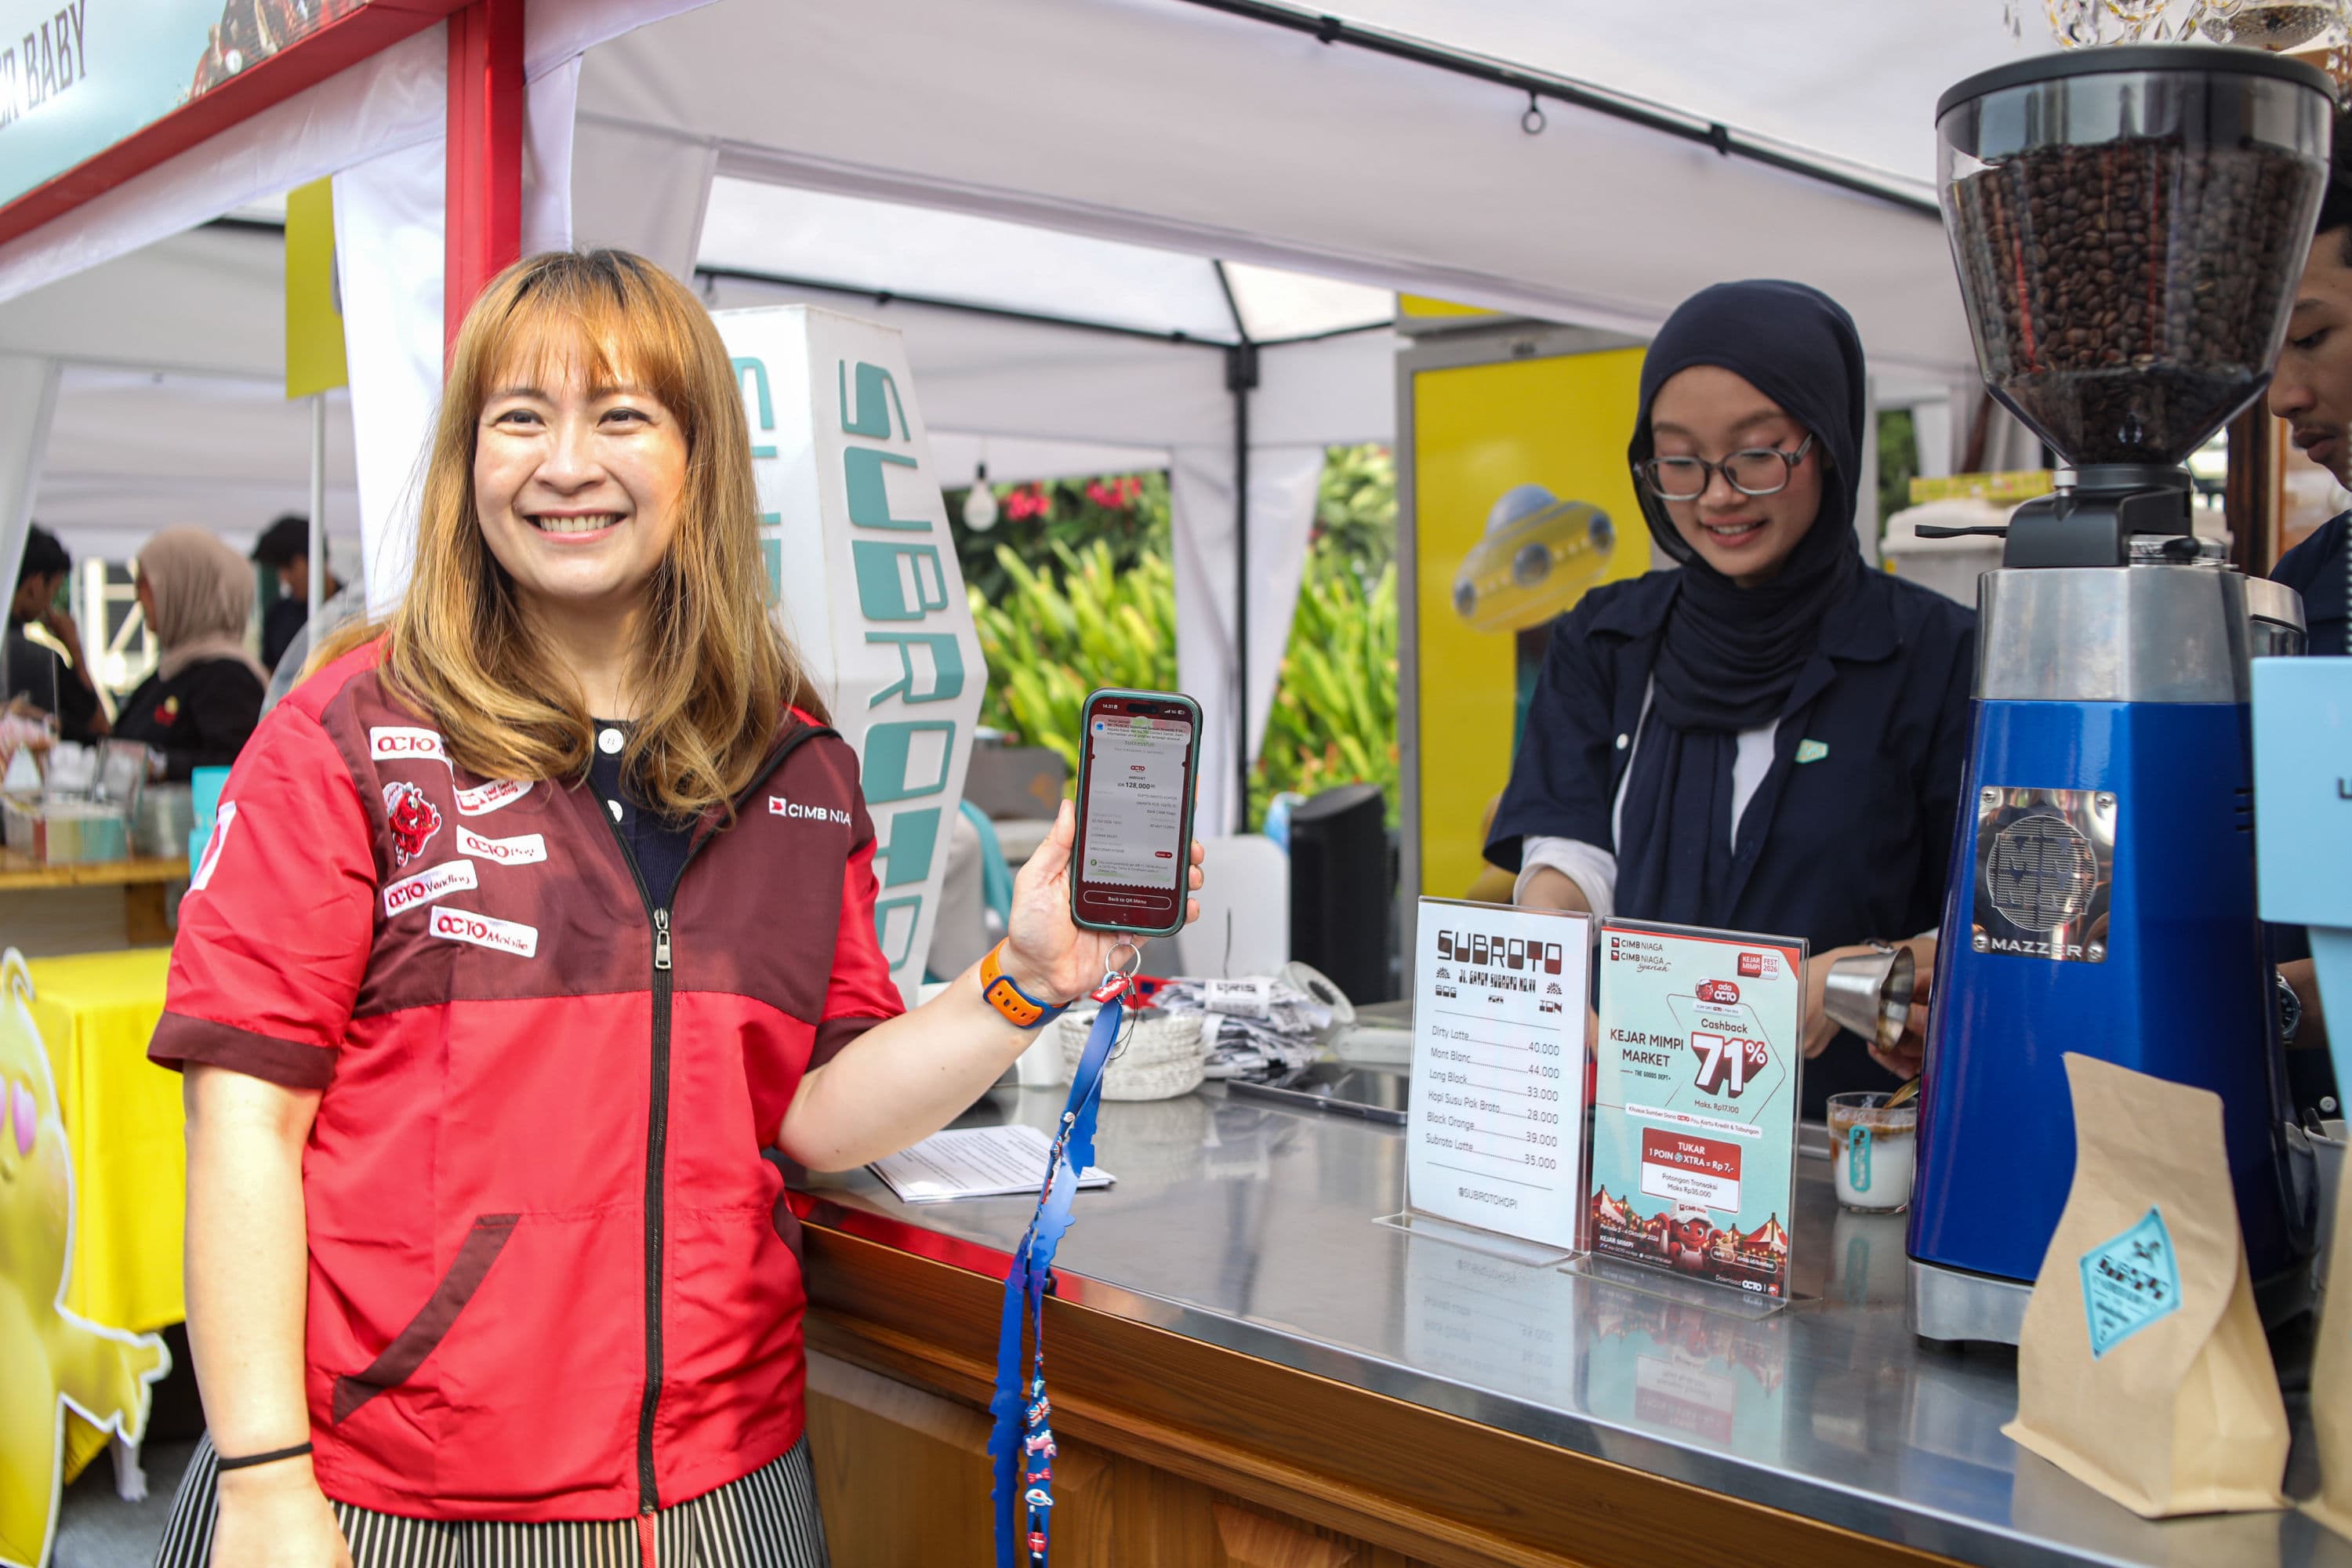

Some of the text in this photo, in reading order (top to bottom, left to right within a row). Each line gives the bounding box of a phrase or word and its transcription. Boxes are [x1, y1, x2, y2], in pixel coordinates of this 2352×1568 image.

[22, 0, 86, 111] BABY
[377, 735, 437, 753] OCTO
[788, 804, 827, 820] CIMB
[466, 837, 509, 858] OCTO
[388, 882, 426, 909] OCTO
[437, 914, 528, 950] OCTO Mobile
[1437, 929, 1563, 975] SUBROTO
[1621, 940, 1663, 952] CIMB NIAGA
[1991, 938, 2082, 957] MAZZER
[1621, 953, 1664, 964] CIMB NIAGA
[1742, 962, 1761, 971] MIMPI
[1469, 971, 1488, 986] GATOT
[1490, 973, 1517, 990] SUBROTO
[1718, 983, 1732, 992] ada
[1714, 990, 1737, 1002] OCTO
[1701, 1018, 1748, 1033] Cashback
[1432, 1025, 1450, 1040] Dirty
[1529, 1041, 1559, 1056] 40.000
[1610, 1028, 1684, 1051] KEJAR MIMPI
[1430, 1047, 1559, 1079] Mont Blanc 44.000
[1622, 1048, 1671, 1067] MARKET
[1691, 1031, 1769, 1096] 71%
[1643, 1071, 1657, 1080] GOODS
[1429, 1069, 1559, 1102] Long Black 33.000
[1428, 1091, 1559, 1124] Kopi Susu Pak Broto 28.000
[1646, 1109, 1663, 1117] Sumber
[1694, 1100, 1712, 1109] Maks.
[1427, 1112, 1557, 1147] Black Orange 39.000
[1425, 1133, 1556, 1170] Subroto Latte 35.000
[1677, 1142, 1705, 1155] TUKAR
[1649, 1148, 1653, 1156] 1
[1653, 1149, 1674, 1160] POIN
[1683, 1155, 1705, 1167] XTRA
[1712, 1160, 1723, 1171] Rp
[1662, 1173, 1719, 1190] Potongan Transaksi
[1668, 1183, 1682, 1192] Maks
[1741, 1279, 1762, 1292] OCTO
